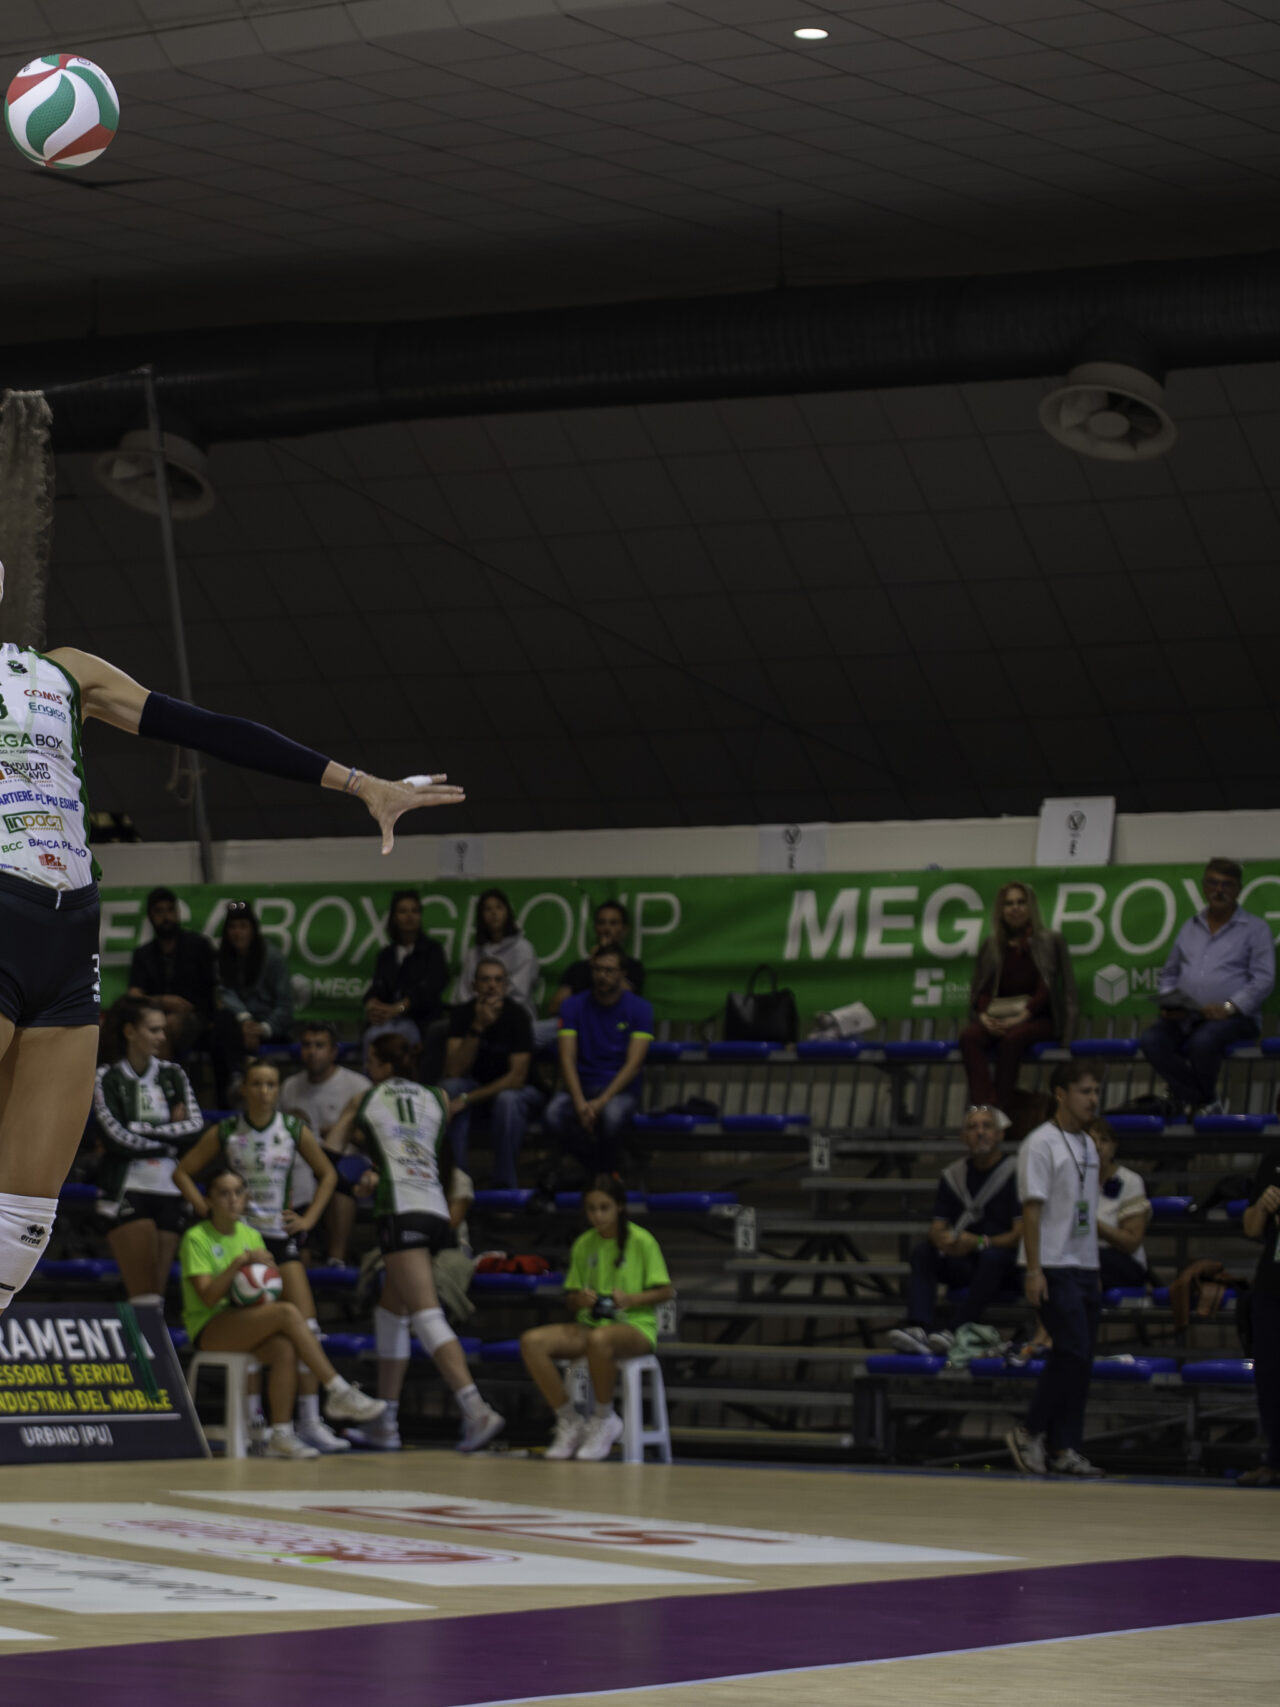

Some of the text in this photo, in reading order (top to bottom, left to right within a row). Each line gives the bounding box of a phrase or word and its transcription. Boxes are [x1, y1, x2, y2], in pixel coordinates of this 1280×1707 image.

[1, 841, 24, 853] BCC
[397, 1097, 416, 1124] 11
[54, 1364, 68, 1386] E
[69, 1363, 135, 1385] SERVIZI
[75, 1390, 111, 1412] DEL
[22, 1425, 80, 1447] URBINO
